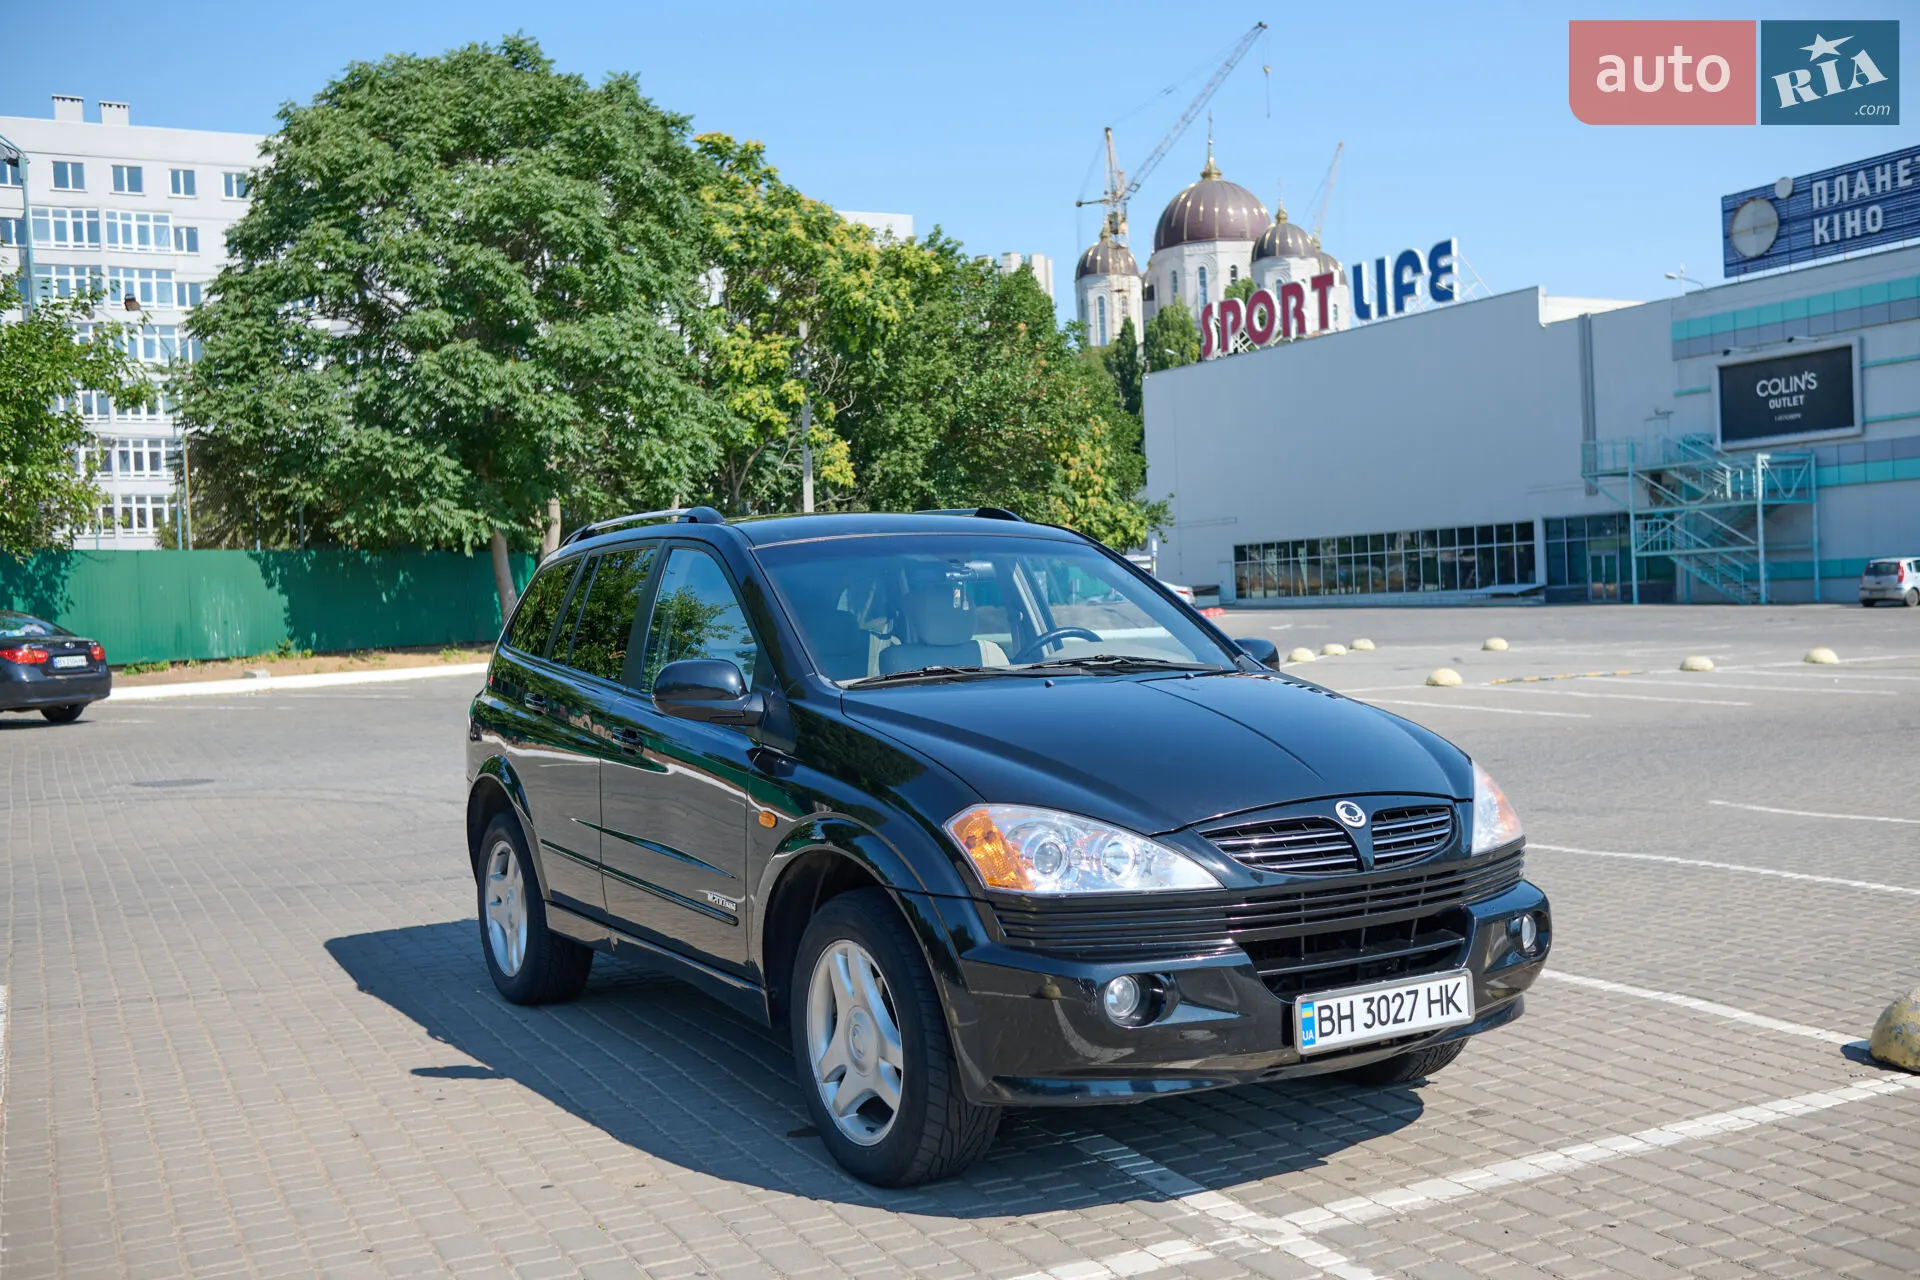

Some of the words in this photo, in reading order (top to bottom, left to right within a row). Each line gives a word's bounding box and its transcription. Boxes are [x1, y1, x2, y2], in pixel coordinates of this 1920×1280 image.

[1812, 156, 1920, 209] ПЛАНЕ
[1813, 205, 1883, 246] КІНО
[1202, 272, 1337, 360] SPORT
[1352, 237, 1458, 321] LIFE
[1756, 370, 1817, 397] COLIN'S
[1769, 394, 1805, 410] OUTLET
[1317, 1000, 1355, 1038] BH
[1363, 989, 1419, 1030] 3027
[1427, 982, 1463, 1018] HK
[1302, 1030, 1314, 1041] UA
